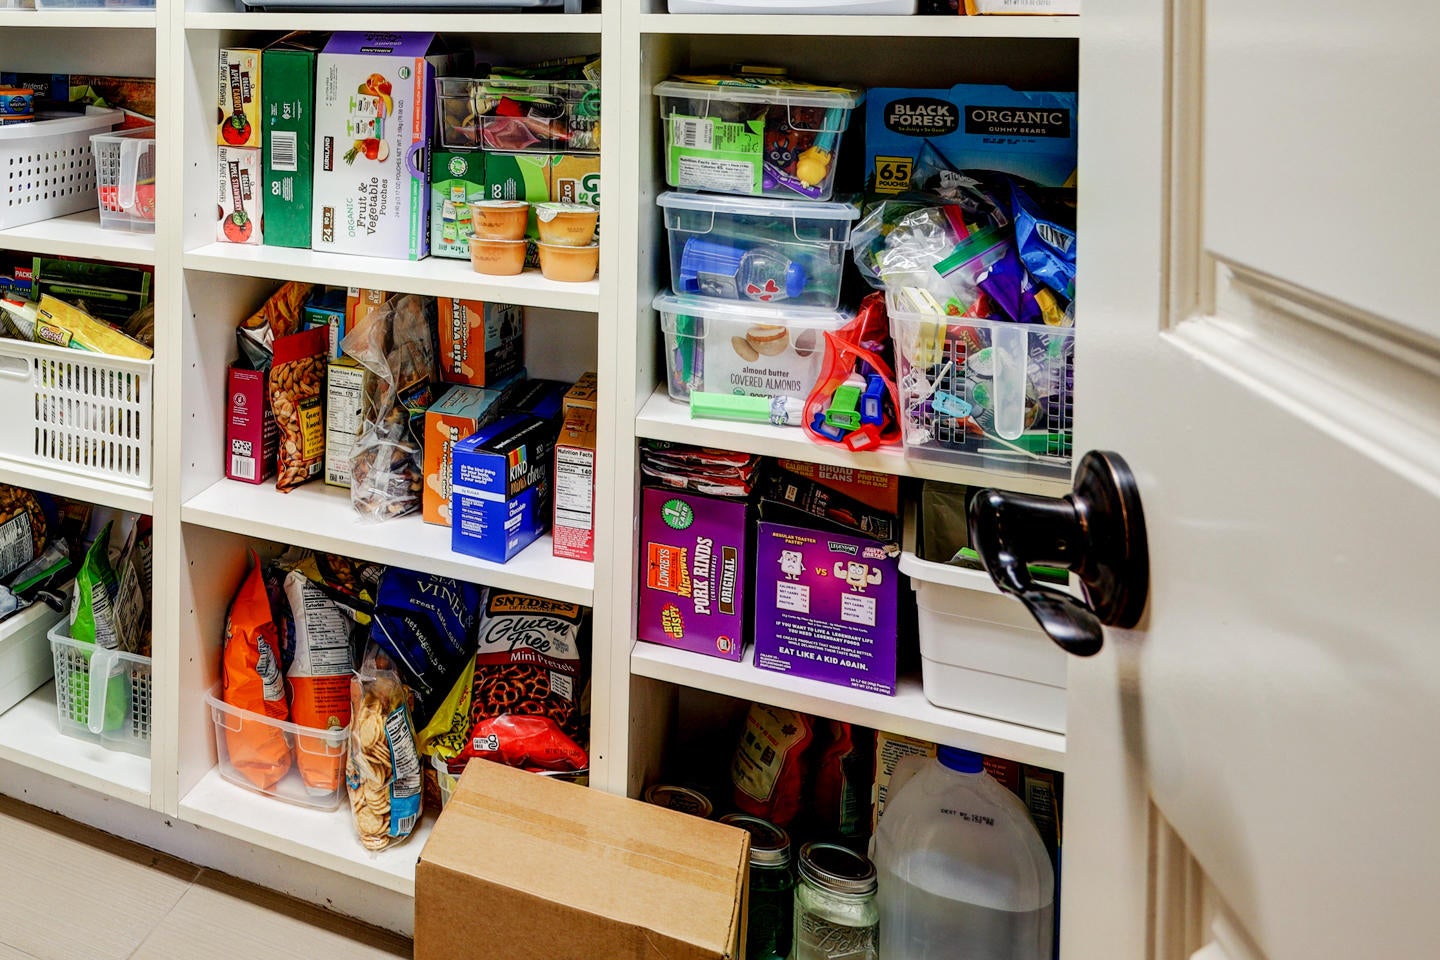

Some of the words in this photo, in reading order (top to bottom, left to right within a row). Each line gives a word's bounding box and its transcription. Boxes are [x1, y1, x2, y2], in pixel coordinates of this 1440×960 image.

[895, 104, 949, 116] BLACK
[971, 109, 1063, 125] ORGANIC
[889, 114, 953, 127] FOREST
[324, 137, 333, 171] KIRKLAND
[879, 163, 908, 181] 65
[367, 177, 379, 235] Vegetable
[380, 179, 388, 215] Pouches
[357, 195, 367, 227] Fruit
[454, 341, 462, 374] BITES
[742, 366, 767, 375] almond
[768, 369, 789, 377] butter
[730, 373, 763, 388] COVERED
[766, 379, 801, 391] ALMONDS
[557, 448, 579, 457] Nutrition
[510, 460, 527, 482] KIND
[819, 472, 853, 482] BEANS
[795, 535, 816, 543] TOASTER
[693, 536, 713, 577] RINDS
[678, 547, 692, 598] Microwave
[721, 558, 735, 603] ORIGINAL
[494, 596, 574, 613] SNYDER'S
[693, 578, 711, 615] PORK
[485, 617, 569, 644] Gluten
[814, 633, 843, 643] LEGENDARY
[832, 631, 861, 641] LEGENDARY
[510, 652, 536, 662] Mini
[538, 655, 575, 672] Pretzels
[779, 647, 795, 655] EAT
[796, 651, 815, 660] LIKE
[824, 656, 838, 664] KID
[840, 659, 869, 671] AGAIN.
